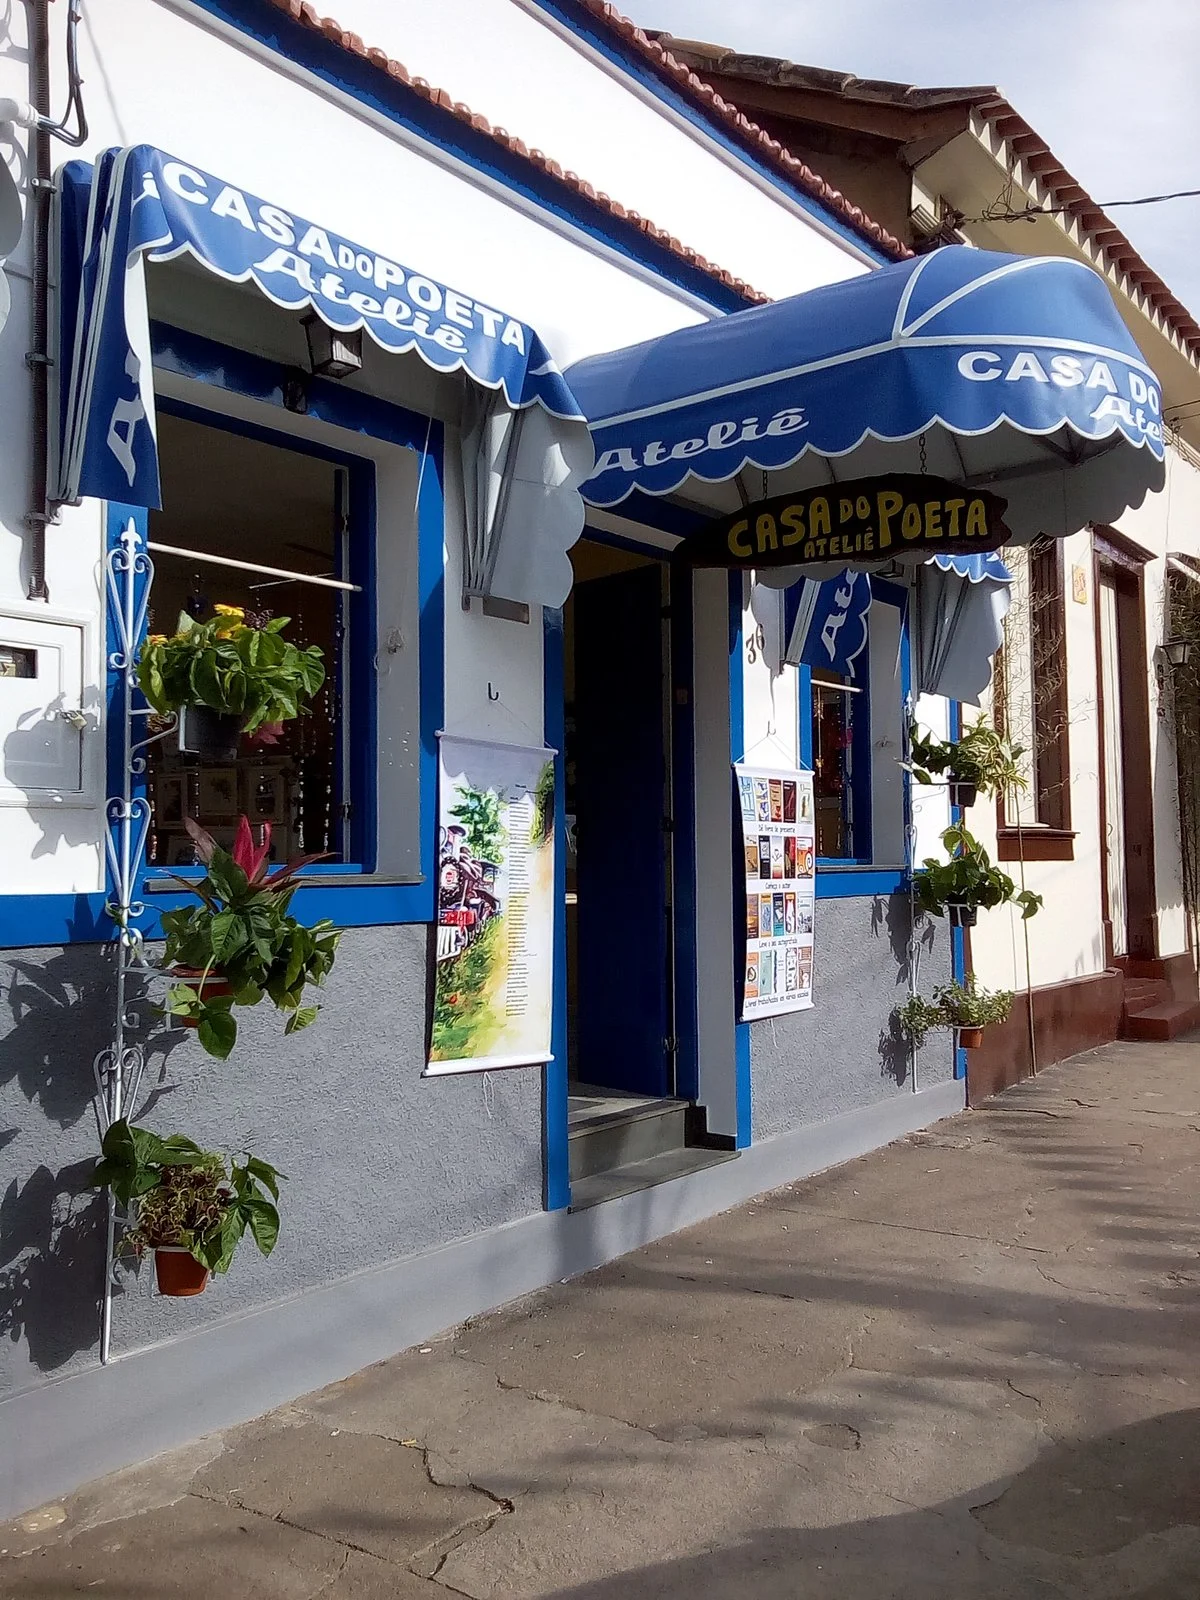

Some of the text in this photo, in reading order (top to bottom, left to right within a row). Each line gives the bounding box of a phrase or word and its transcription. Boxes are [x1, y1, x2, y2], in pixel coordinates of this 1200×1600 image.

[163, 162, 525, 356] CASA DO POETA
[253, 248, 469, 354] Ateliê
[957, 351, 1160, 416] CASA DO
[588, 407, 810, 479] Ateliê
[727, 491, 989, 558] CASA DO POETA
[803, 526, 874, 559] ATELIÊ
